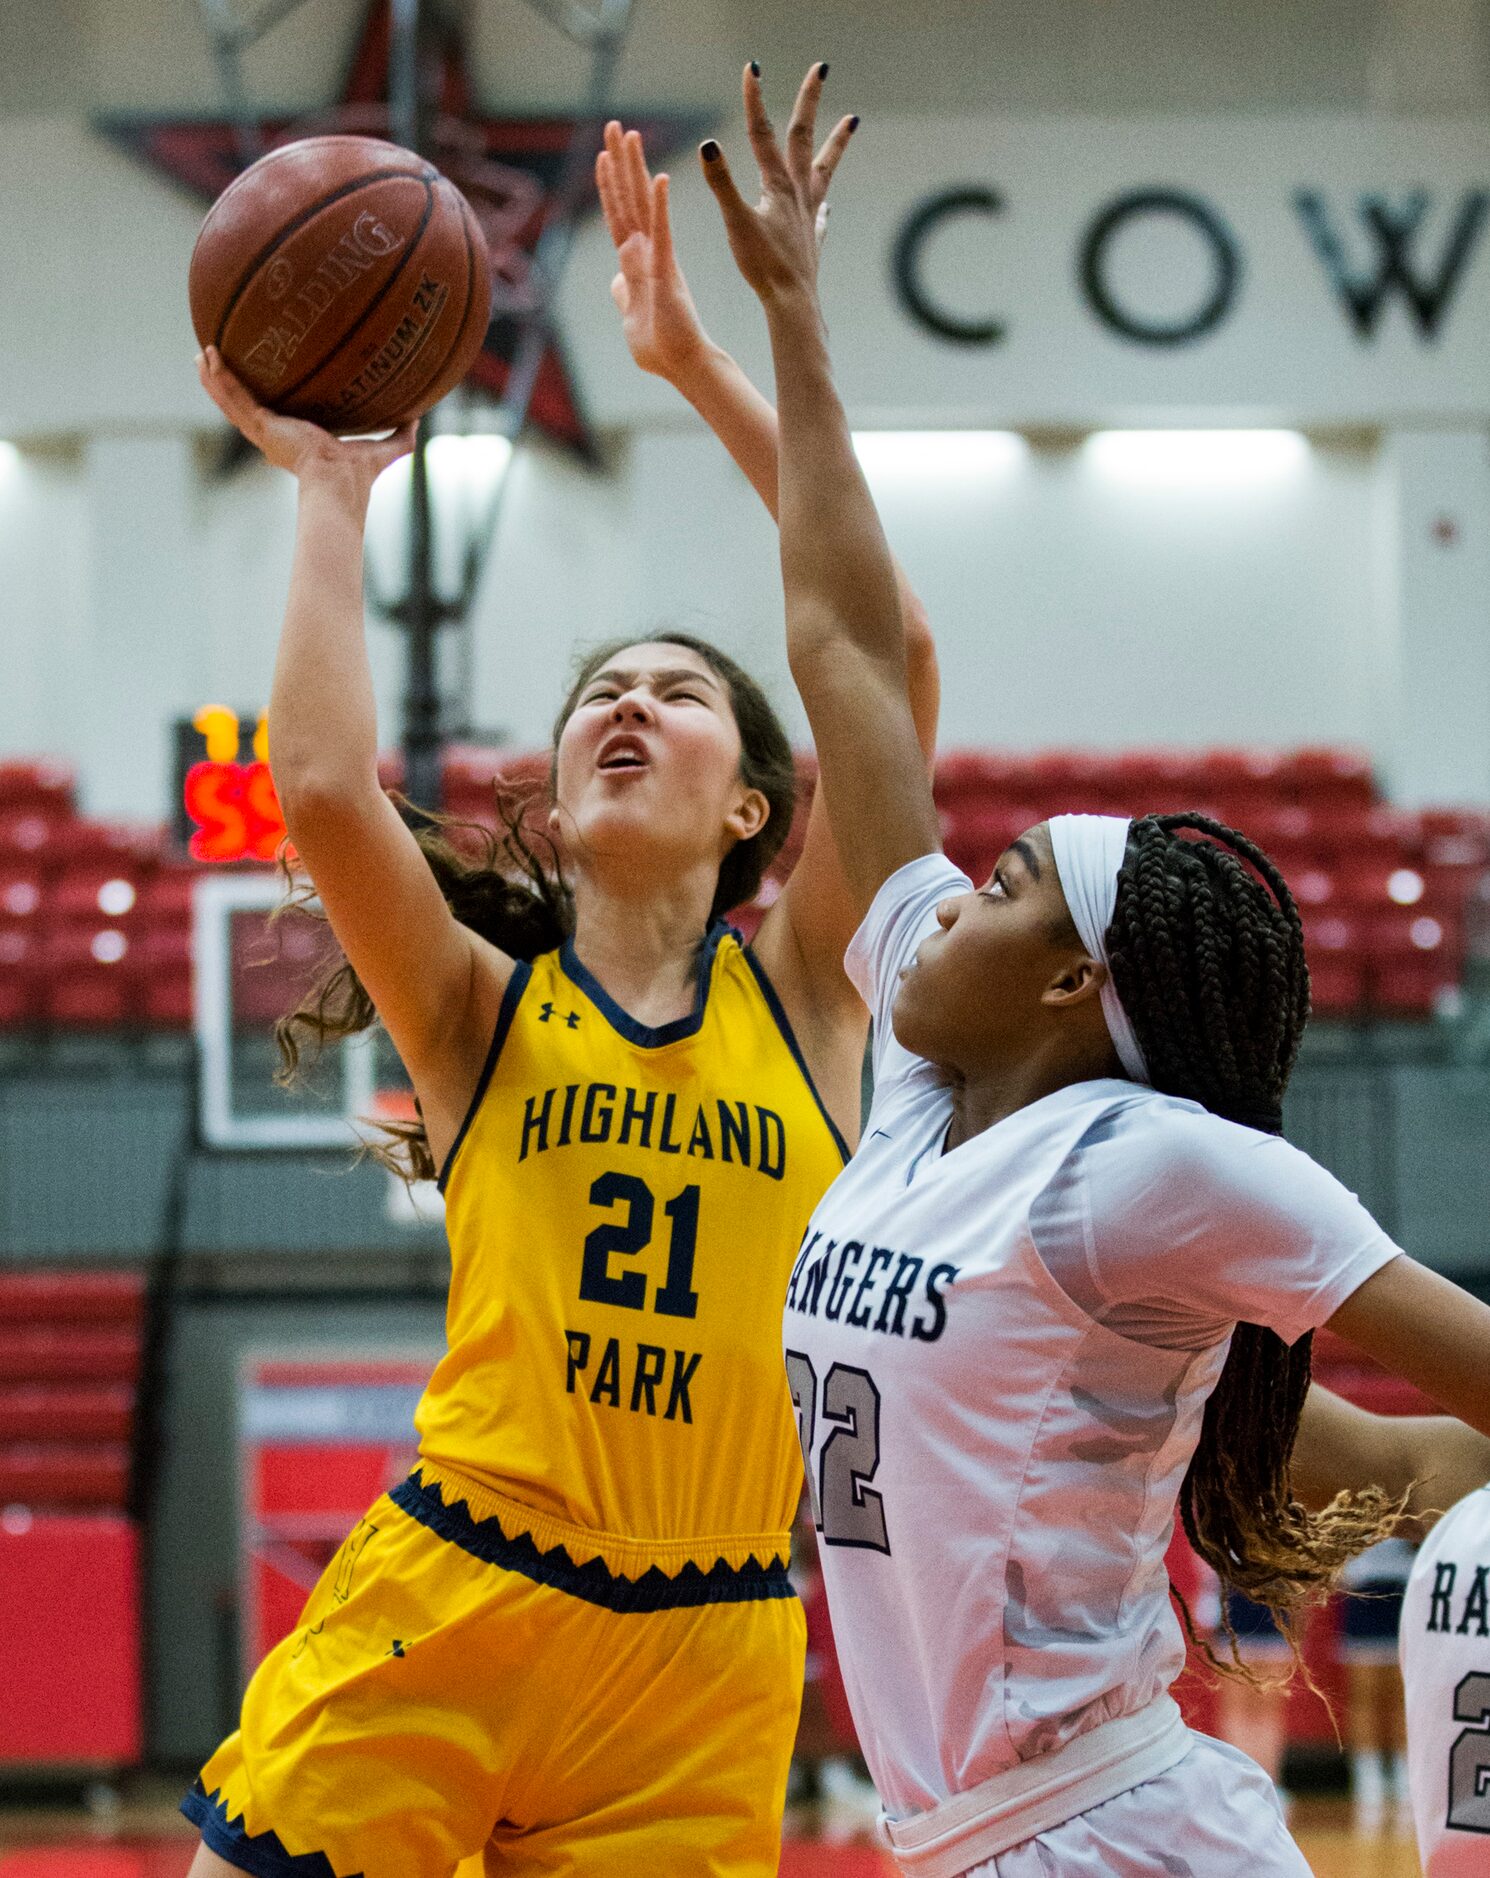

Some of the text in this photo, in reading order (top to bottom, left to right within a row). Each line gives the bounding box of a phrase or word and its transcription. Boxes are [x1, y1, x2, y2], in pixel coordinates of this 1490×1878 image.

[891, 186, 1490, 352] COW
[193, 704, 270, 763] 1
[518, 1082, 786, 1181] HIGHLAND
[579, 1171, 701, 1318] 21
[785, 1226, 961, 1343] ANGERS
[564, 1329, 703, 1424] PARK
[1427, 1562, 1490, 1636] RA
